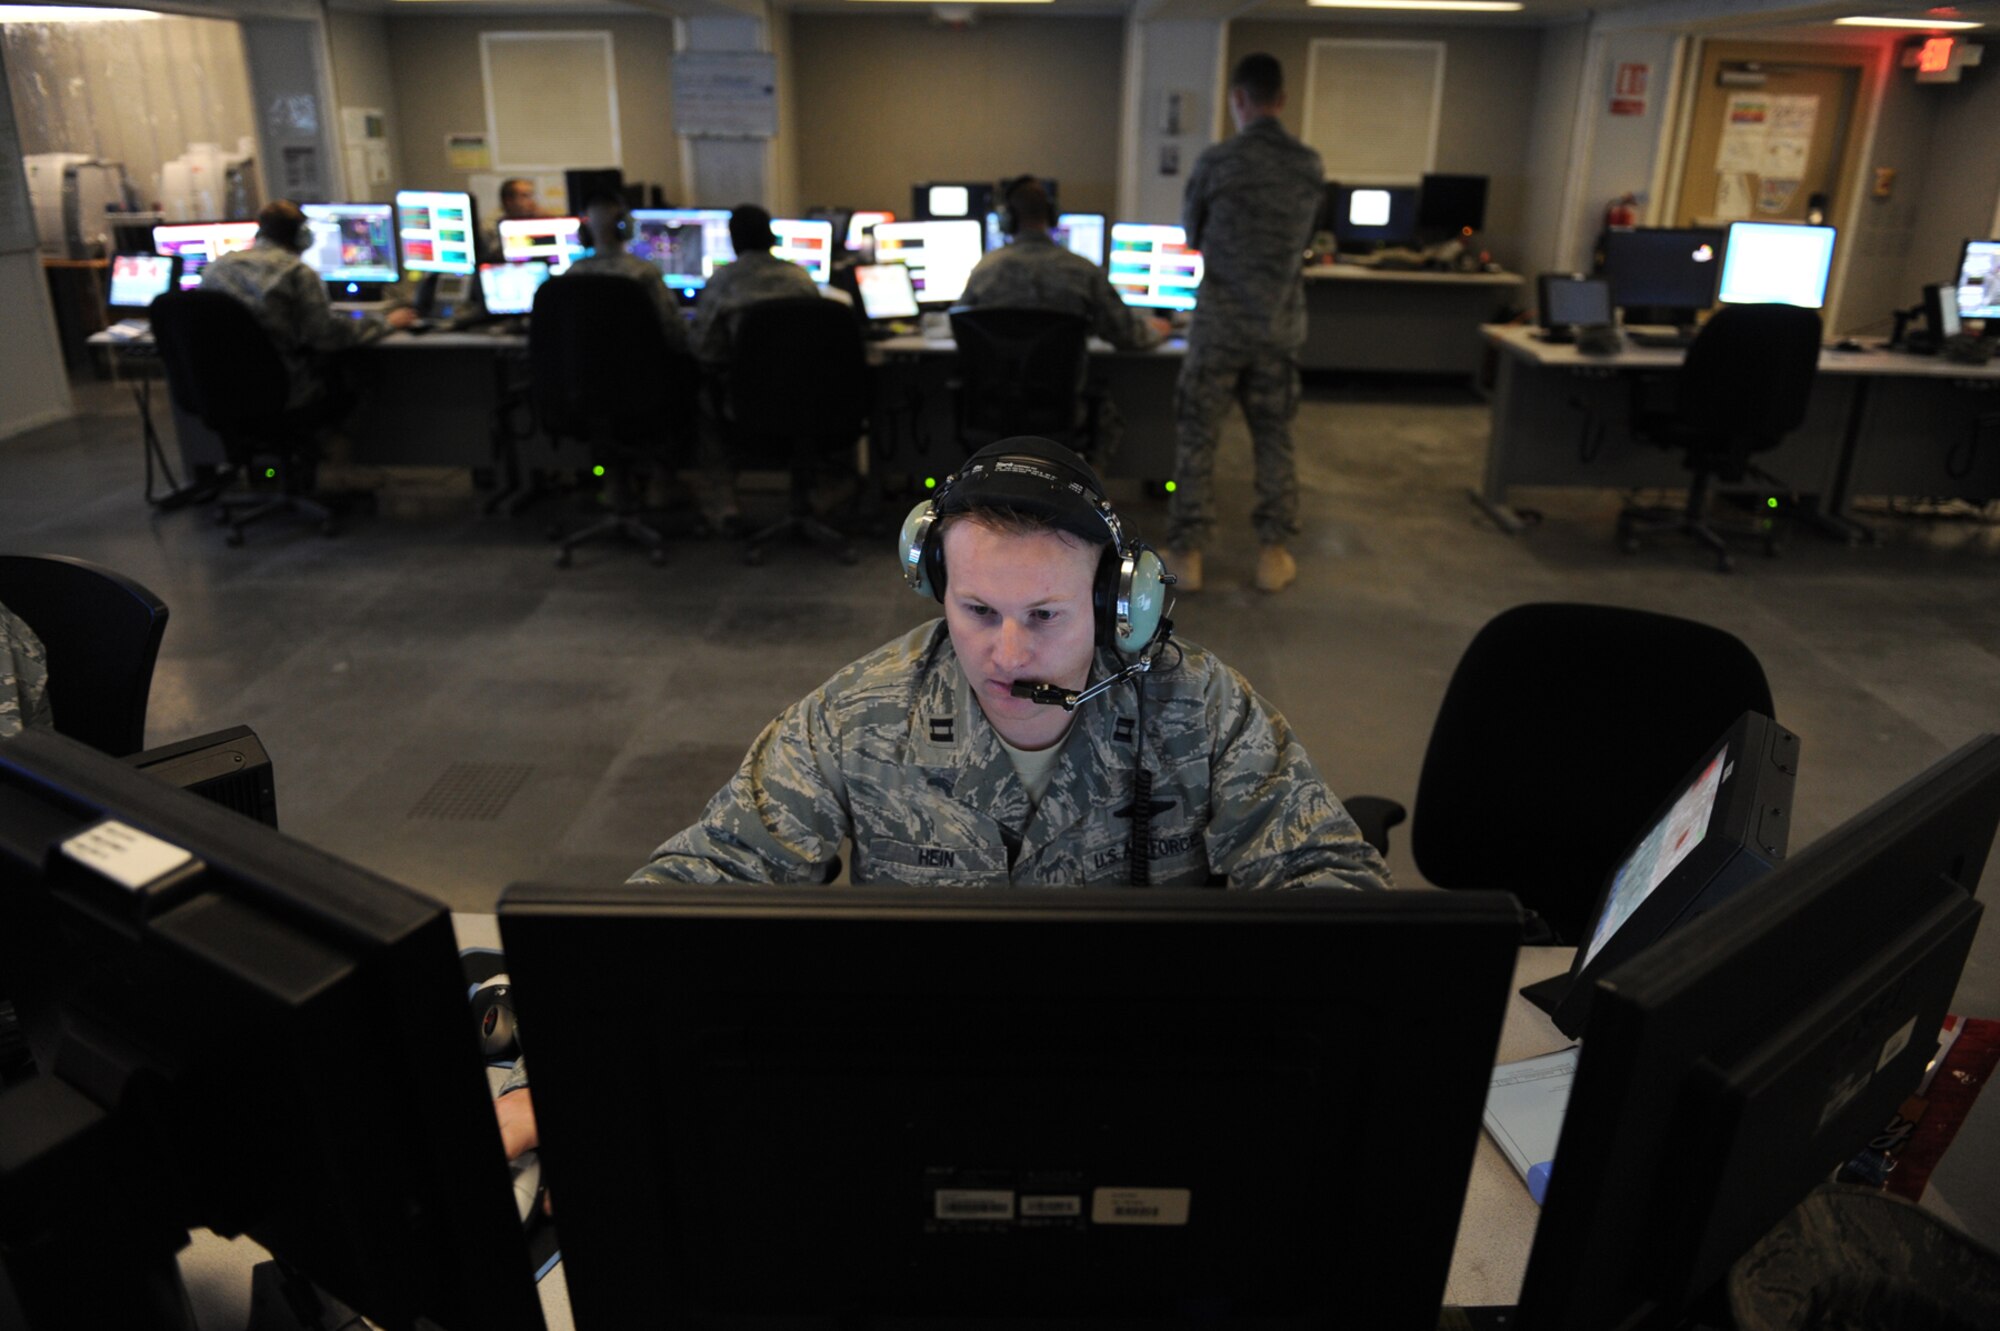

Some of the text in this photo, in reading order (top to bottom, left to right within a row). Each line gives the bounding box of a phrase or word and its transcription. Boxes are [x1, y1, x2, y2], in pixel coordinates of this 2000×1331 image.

[918, 848, 955, 869] HEIN
[1094, 847, 1119, 869] U.S.
[1148, 832, 1200, 856] FORCE
